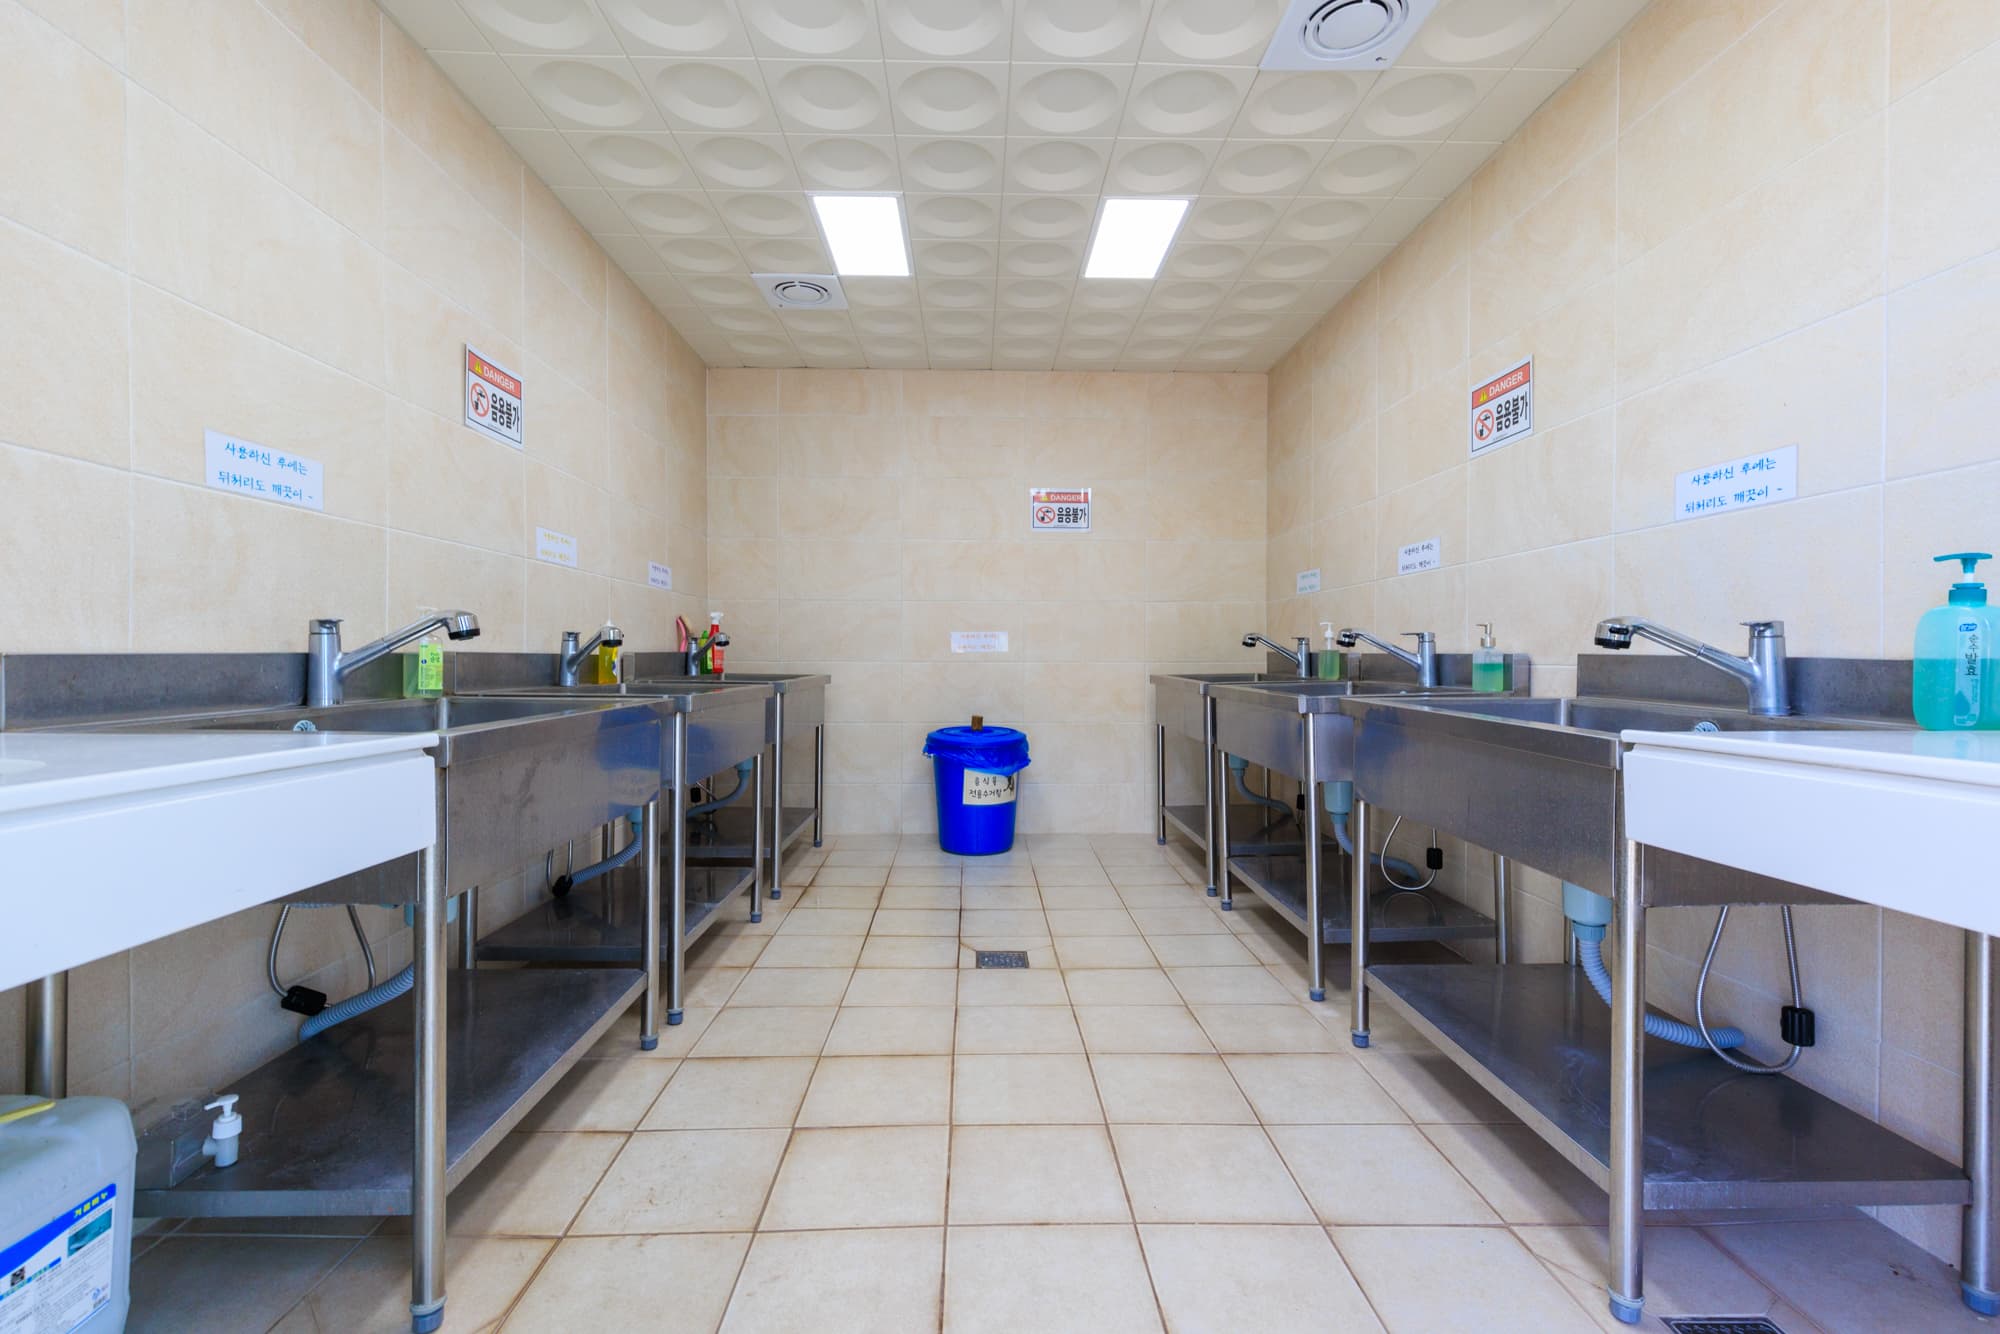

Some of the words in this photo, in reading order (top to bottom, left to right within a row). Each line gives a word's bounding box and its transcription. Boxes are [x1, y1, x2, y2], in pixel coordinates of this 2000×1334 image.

[483, 365, 516, 392] DANGER
[1488, 371, 1523, 397] DANGER
[491, 392, 520, 433] 음용불가
[1495, 391, 1528, 433] 음용불가
[225, 441, 271, 467] 사용하신
[277, 455, 309, 476] 후에는
[1691, 465, 1735, 487] 사용하신
[1740, 457, 1777, 475] 후에는
[271, 483, 303, 501] 깨끗이
[1050, 494, 1084, 502] DANGER
[1733, 484, 1769, 504] 깨끗이
[1057, 506, 1087, 524] 음용불가
